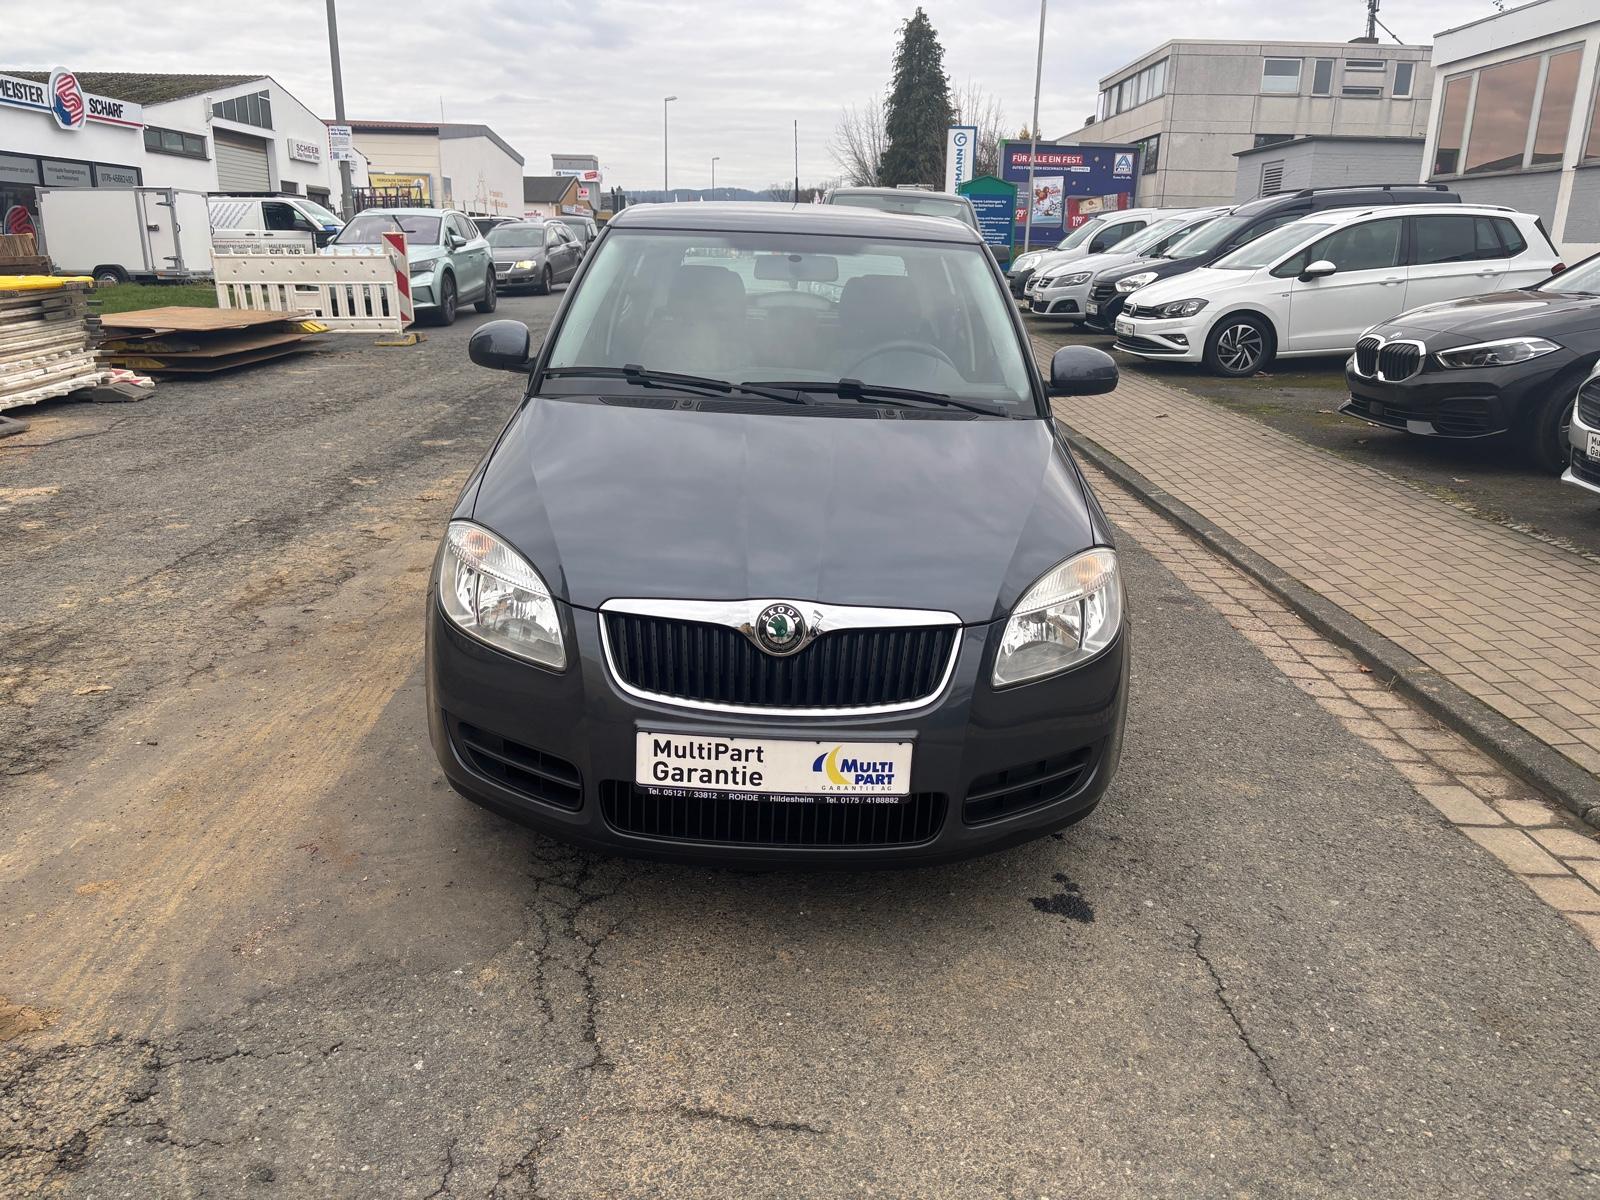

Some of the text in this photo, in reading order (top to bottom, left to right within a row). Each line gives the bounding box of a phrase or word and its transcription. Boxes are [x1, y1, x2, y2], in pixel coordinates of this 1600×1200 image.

[89, 97, 123, 118] SCHARF
[296, 143, 319, 154] SCHEER
[1013, 153, 1027, 162] FÜR
[1049, 155, 1061, 163] EIN
[1063, 156, 1082, 164] FEST.
[653, 739, 764, 763] MultiPart
[652, 760, 763, 786] Garantie
[840, 758, 894, 773] MULTI
[854, 773, 894, 785] PART
[648, 787, 661, 795] Tel.
[663, 788, 686, 797] 05121
[693, 790, 717, 799] 33812
[728, 793, 759, 801] ROHDE
[769, 794, 814, 803] Hildesheim
[825, 796, 838, 804] Tel.
[840, 796, 859, 804] 0175
